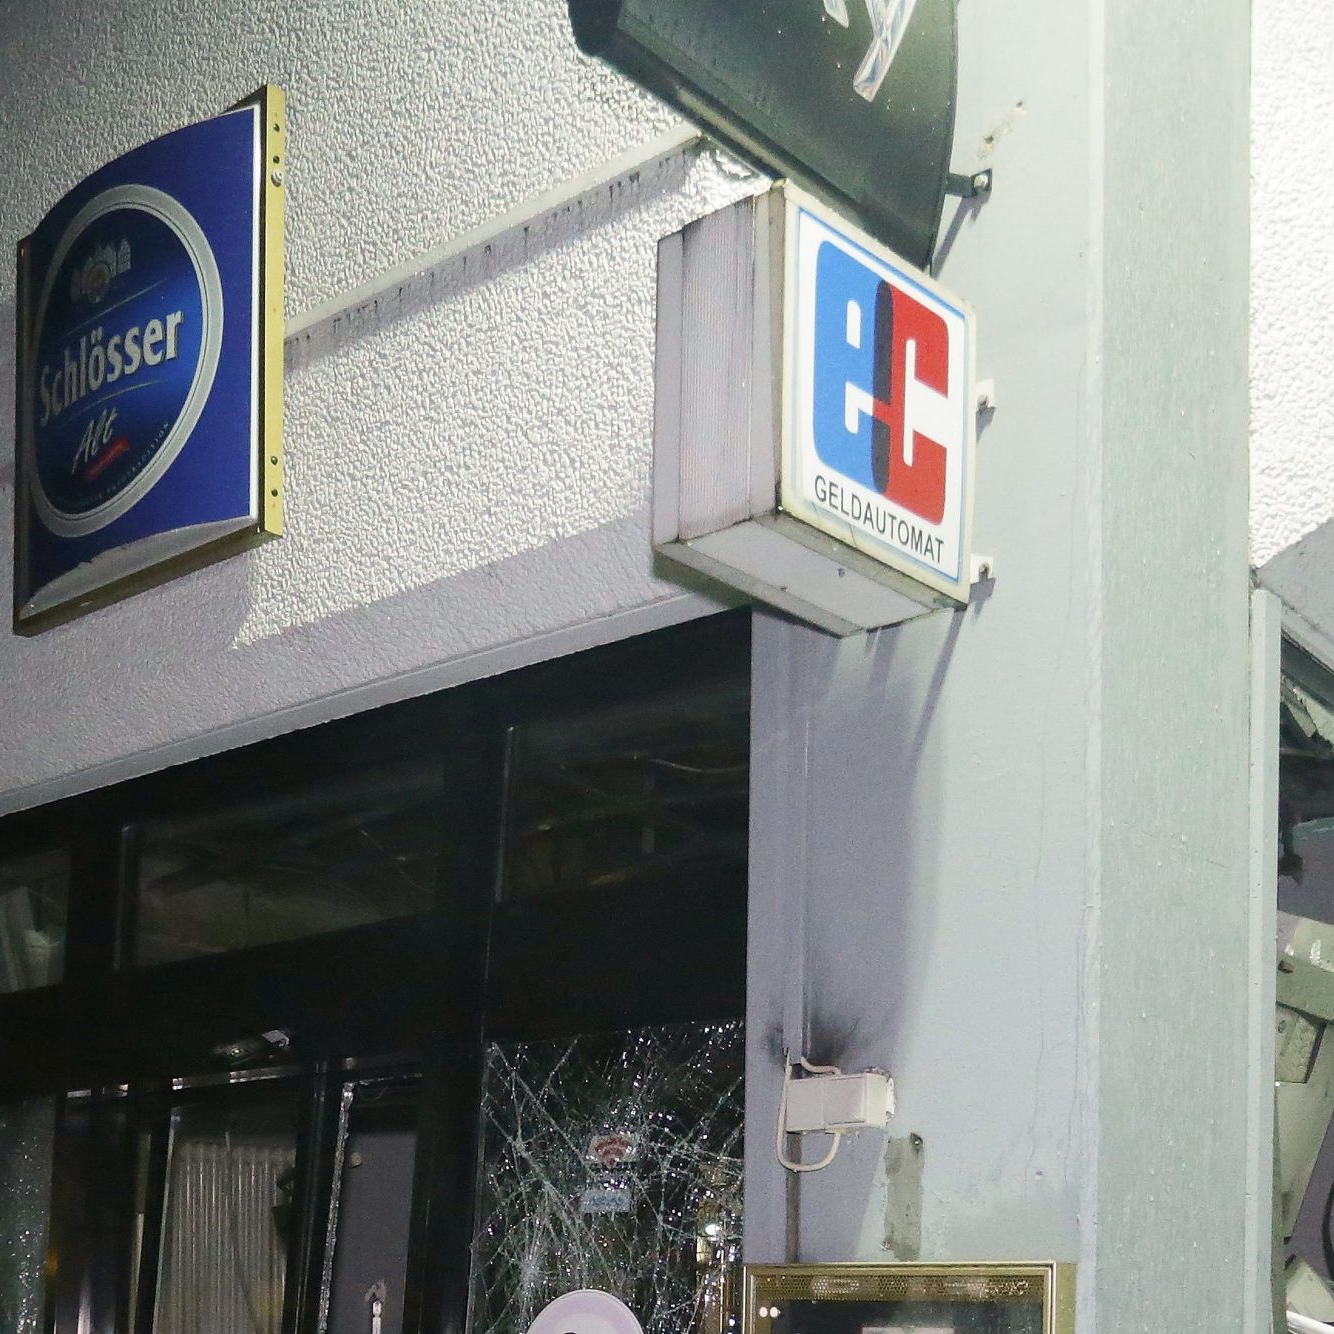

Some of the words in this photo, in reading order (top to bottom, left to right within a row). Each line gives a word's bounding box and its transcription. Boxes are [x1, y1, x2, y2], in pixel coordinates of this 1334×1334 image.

[40, 310, 183, 427] Schlösser
[71, 407, 118, 475] Alt
[814, 474, 944, 563] GELDAUTOMAT
